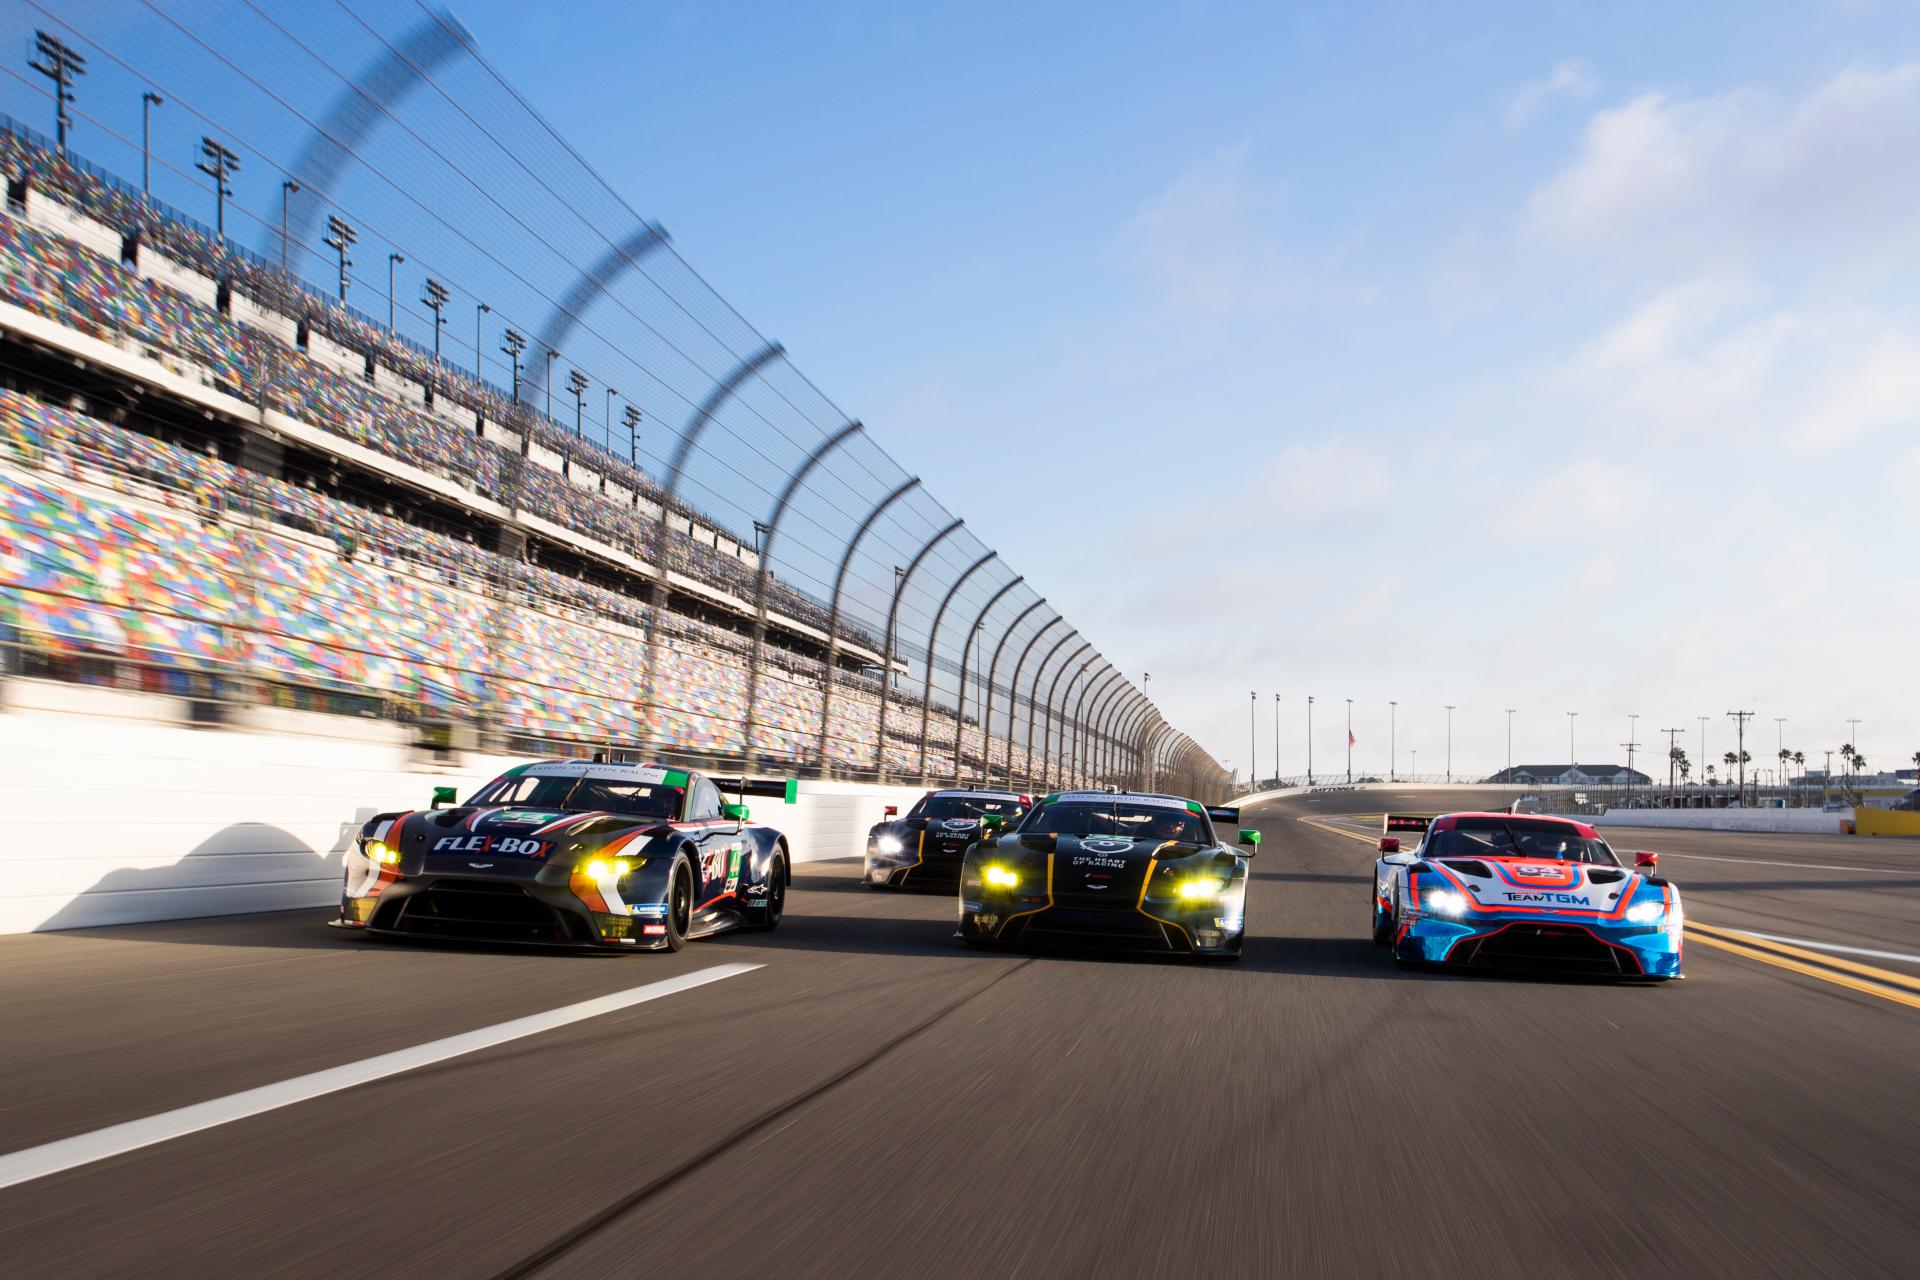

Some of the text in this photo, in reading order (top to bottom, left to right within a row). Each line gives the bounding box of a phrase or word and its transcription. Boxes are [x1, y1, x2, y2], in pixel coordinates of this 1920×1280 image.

[570, 765, 617, 773] MARTIN
[620, 767, 662, 780] RACING
[1143, 798, 1184, 807] RACING
[432, 833, 553, 860] FLEX-BOX
[730, 851, 741, 877] 44
[1088, 860, 1125, 869] RACING
[1094, 857, 1127, 865] HEART
[1520, 866, 1559, 874] 64
